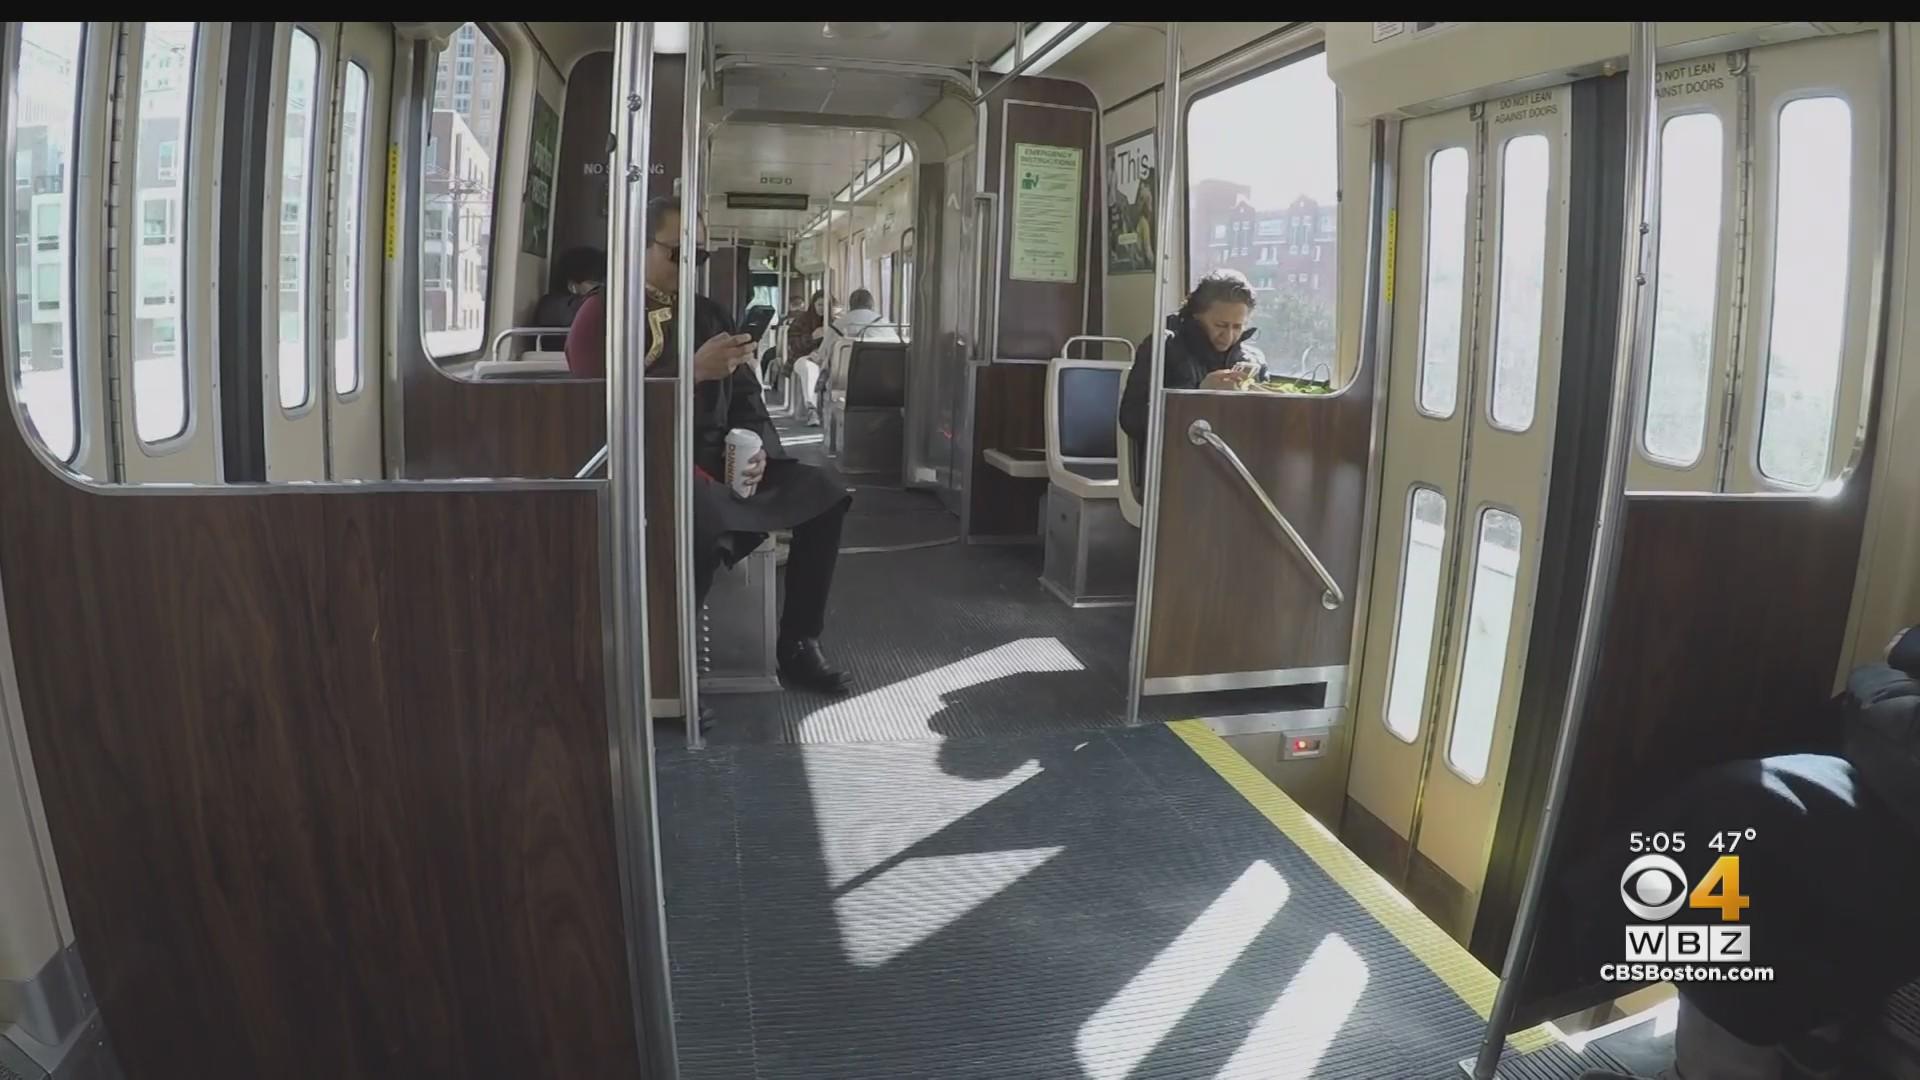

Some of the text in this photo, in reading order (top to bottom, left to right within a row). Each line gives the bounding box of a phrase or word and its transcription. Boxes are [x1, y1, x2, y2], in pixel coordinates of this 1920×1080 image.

[1664, 67, 1686, 81] NOT
[1687, 61, 1716, 78] LEAN
[1686, 77, 1724, 95] DOORS
[1513, 94, 1529, 108] NOT
[1530, 89, 1553, 105] LEAN
[583, 163, 604, 175] NO
[1117, 147, 1150, 185] This
